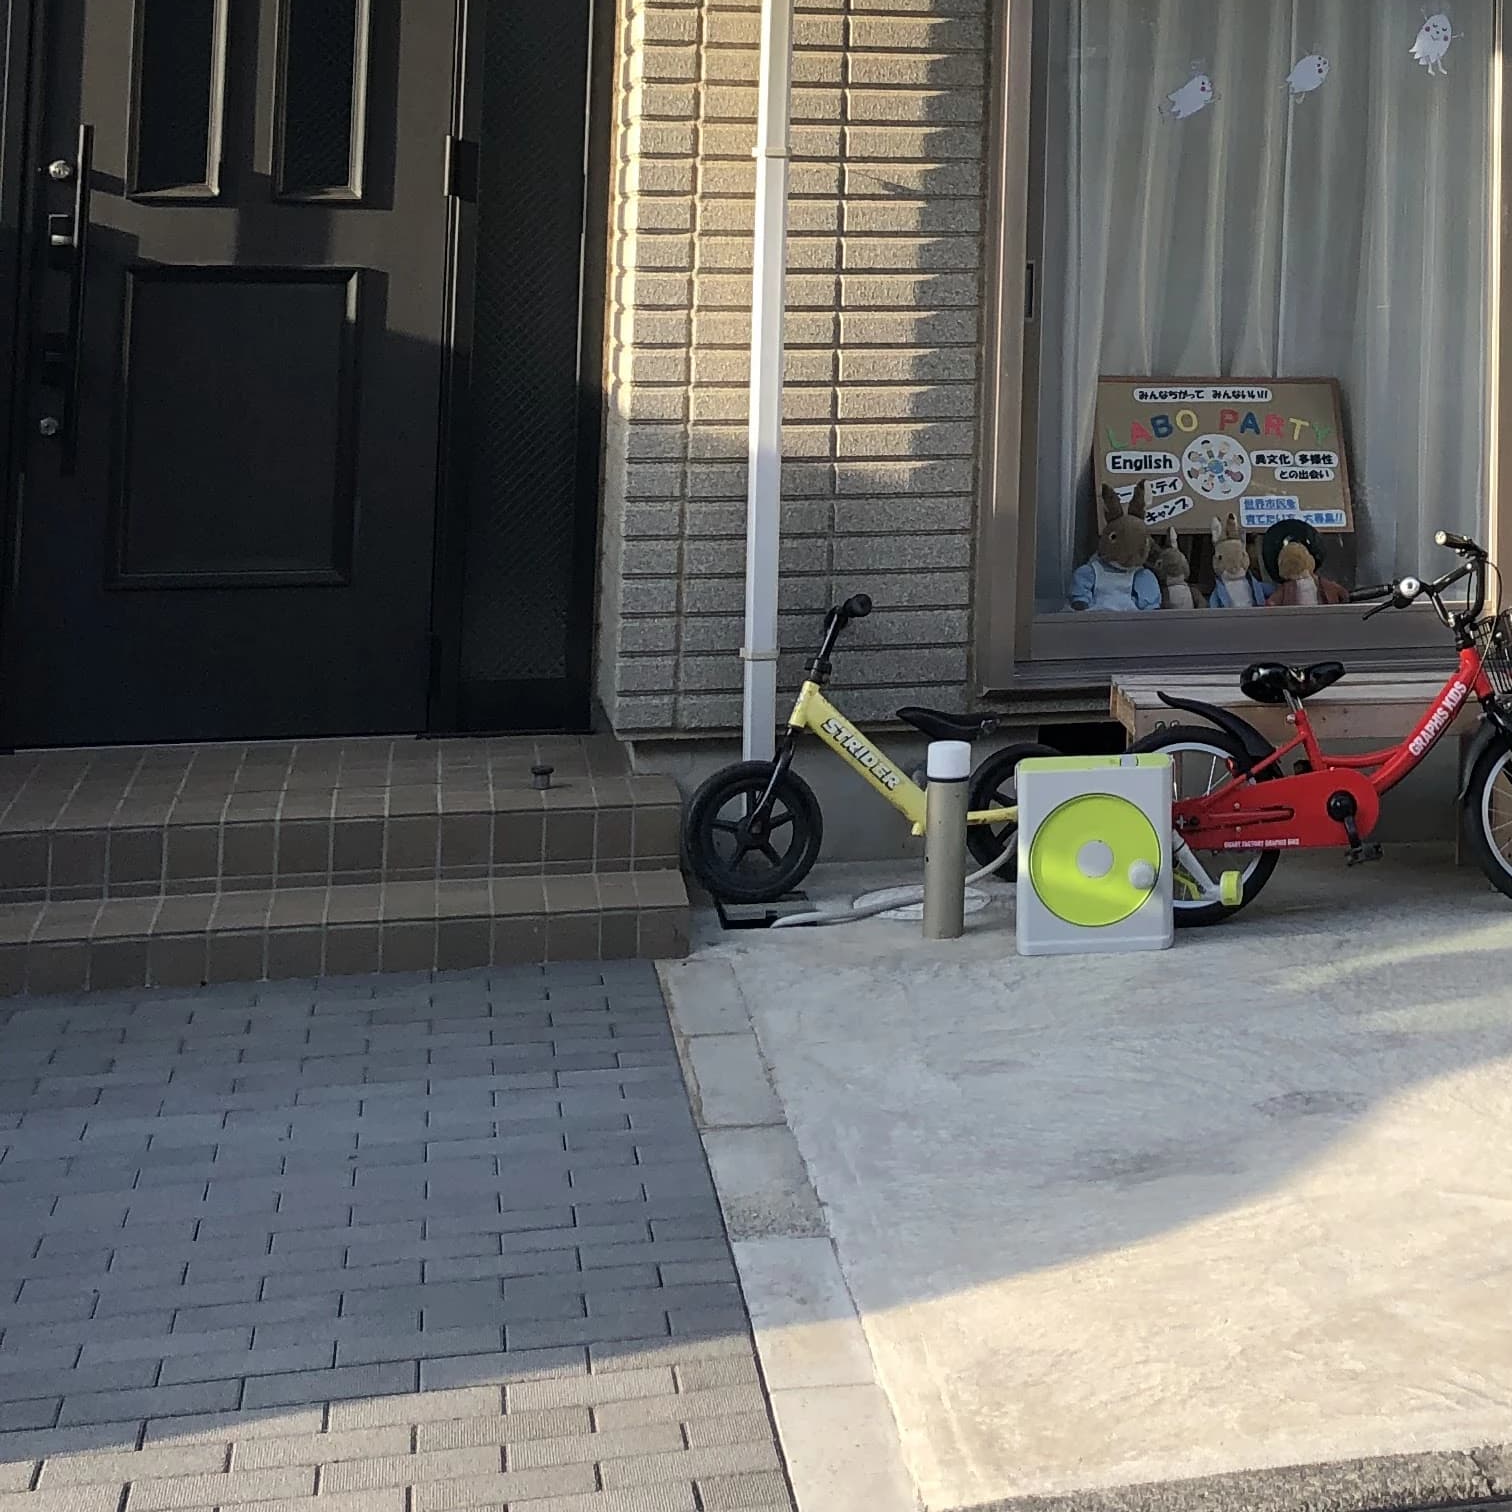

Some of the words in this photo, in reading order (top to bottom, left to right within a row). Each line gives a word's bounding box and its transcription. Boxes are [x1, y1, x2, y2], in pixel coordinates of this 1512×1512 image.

[1106, 409, 1198, 450] LABO
[1218, 408, 1332, 445] PARTY
[1111, 454, 1173, 471] English
[1408, 706, 1449, 756] GRAPHIS
[1441, 680, 1467, 712] KIDS
[820, 718, 900, 791] STRIDER
